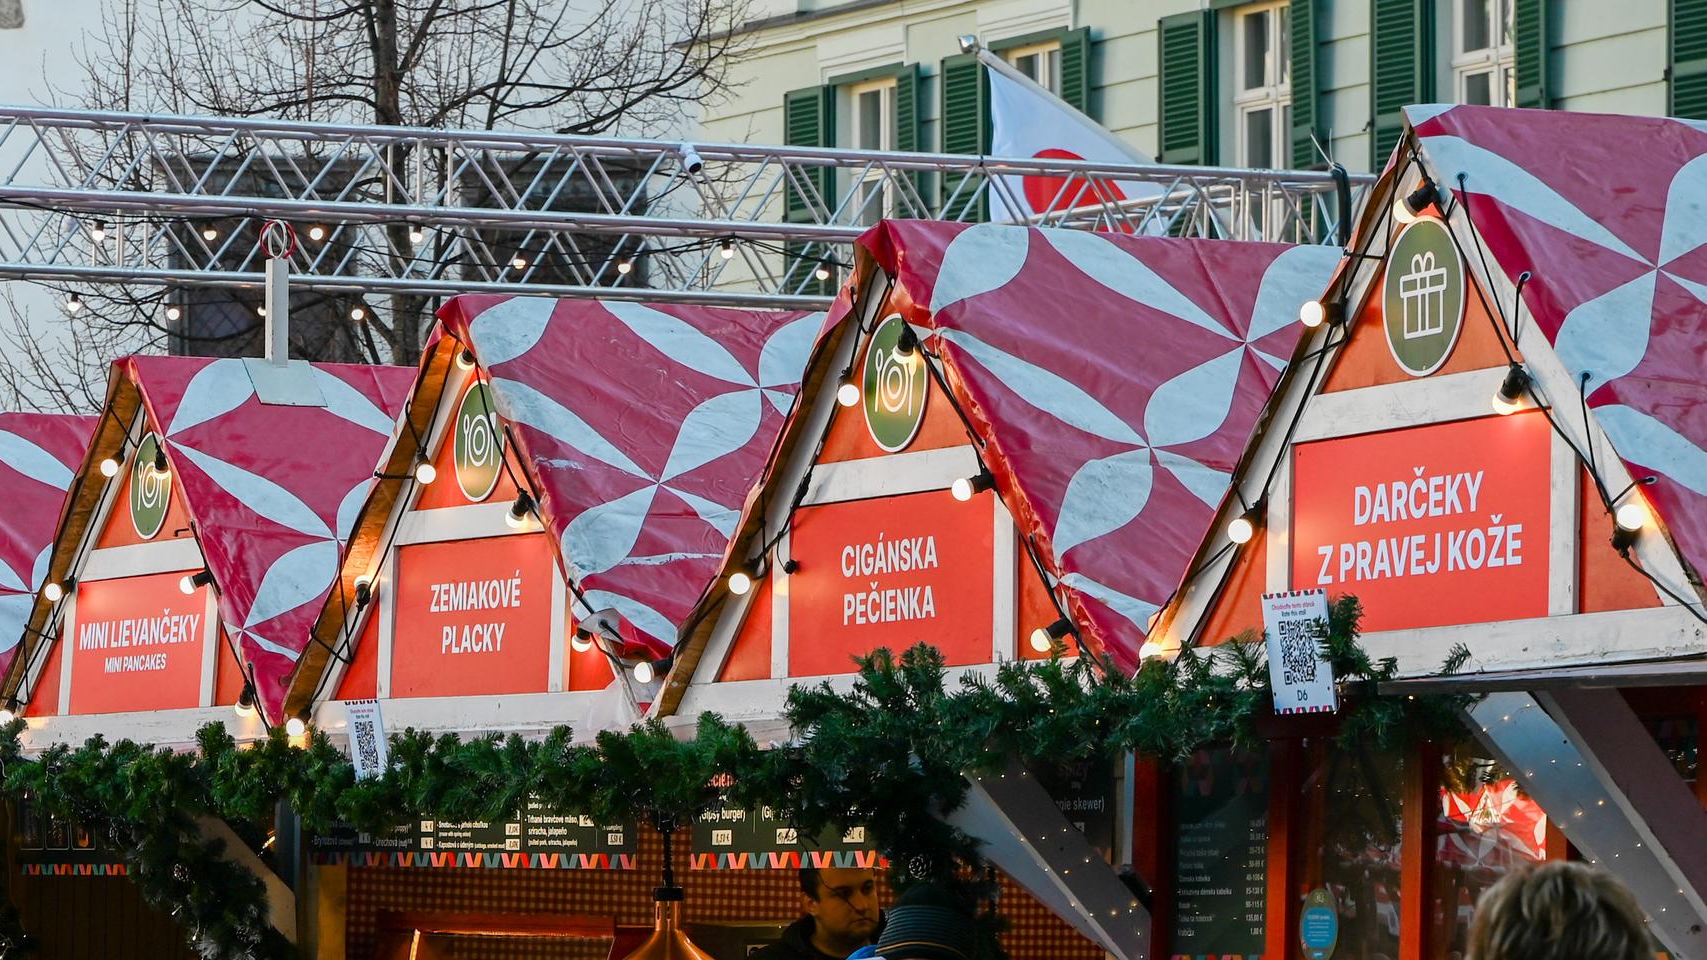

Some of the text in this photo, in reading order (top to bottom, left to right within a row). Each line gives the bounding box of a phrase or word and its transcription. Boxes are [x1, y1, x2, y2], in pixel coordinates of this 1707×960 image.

[1353, 465, 1485, 526] DARČEKY
[841, 532, 938, 577] CIGÁNSKA
[1316, 513, 1523, 585] Z PRAVEJ KOŽE
[429, 570, 521, 613] ZEMIAKOVÉ
[843, 581, 936, 625] PEČIENKA
[79, 608, 200, 651] MINI LIEVANČEKY
[441, 622, 506, 655] PLACKY
[104, 653, 166, 674] MINI PANCAKES
[1297, 690, 1308, 701] D6
[721, 807, 746, 822] burger)
[1074, 796, 1104, 813] skewer)
